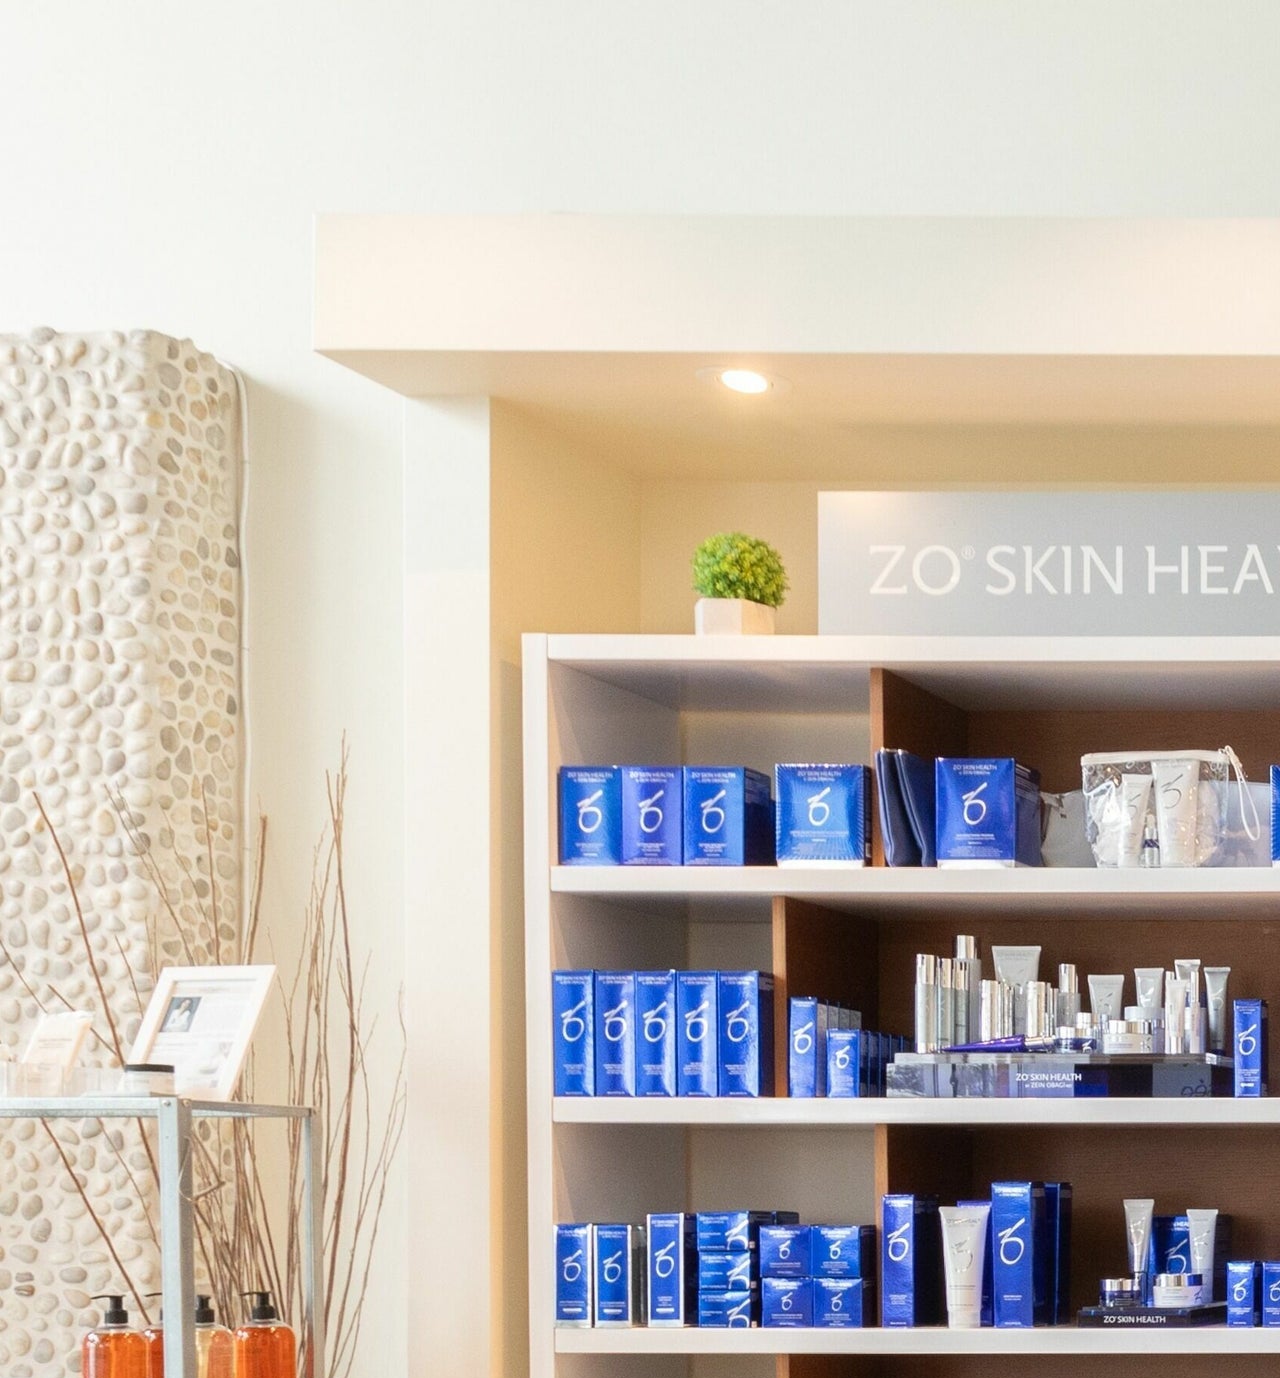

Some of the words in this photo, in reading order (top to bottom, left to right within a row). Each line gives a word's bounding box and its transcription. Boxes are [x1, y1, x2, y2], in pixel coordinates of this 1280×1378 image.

[986, 544, 1123, 596] SKIN
[1031, 1073, 1048, 1082] SKIN
[1050, 1073, 1082, 1082] HEALTH
[1117, 1315, 1135, 1324] SKIN
[1136, 1315, 1167, 1324] HEALTH
